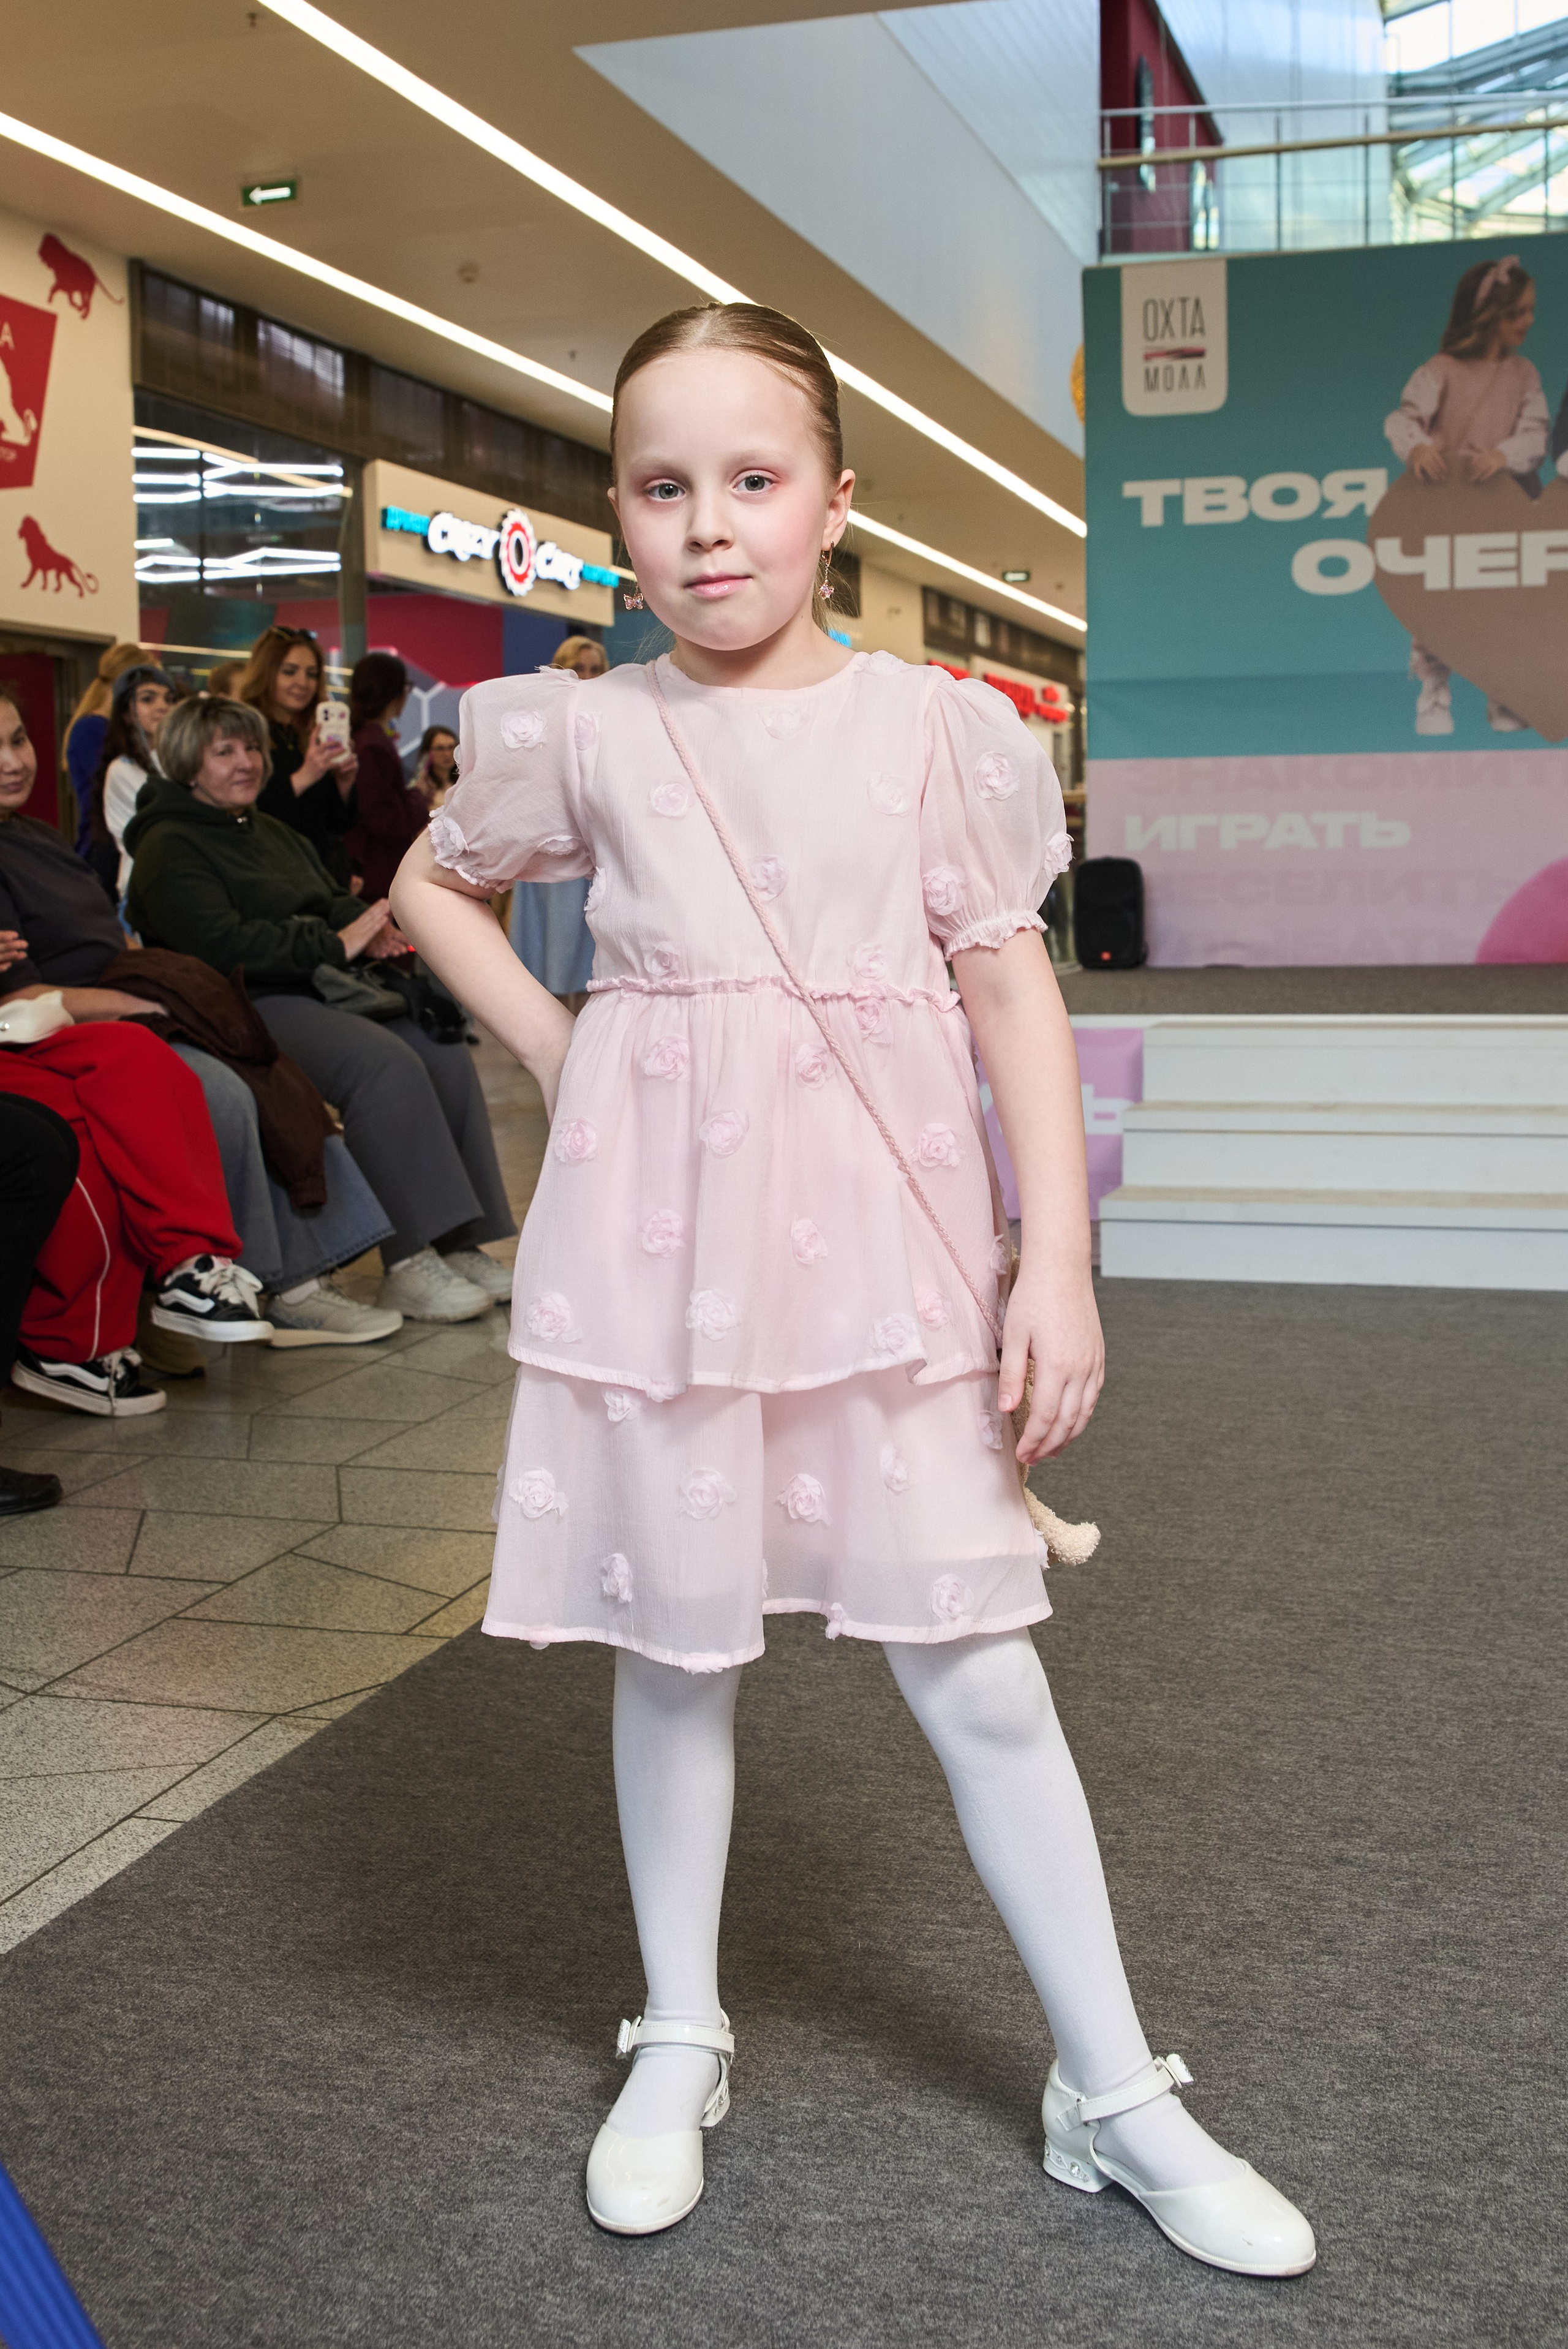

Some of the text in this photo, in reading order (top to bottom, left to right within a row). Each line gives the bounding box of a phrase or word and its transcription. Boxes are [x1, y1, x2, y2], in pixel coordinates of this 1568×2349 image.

[1142, 296, 1207, 342] ОХТА
[1144, 363, 1207, 393] МОЛЛ
[1122, 467, 1388, 527] ТВОЯ
[1125, 811, 1412, 852] ИГРАТЬ
